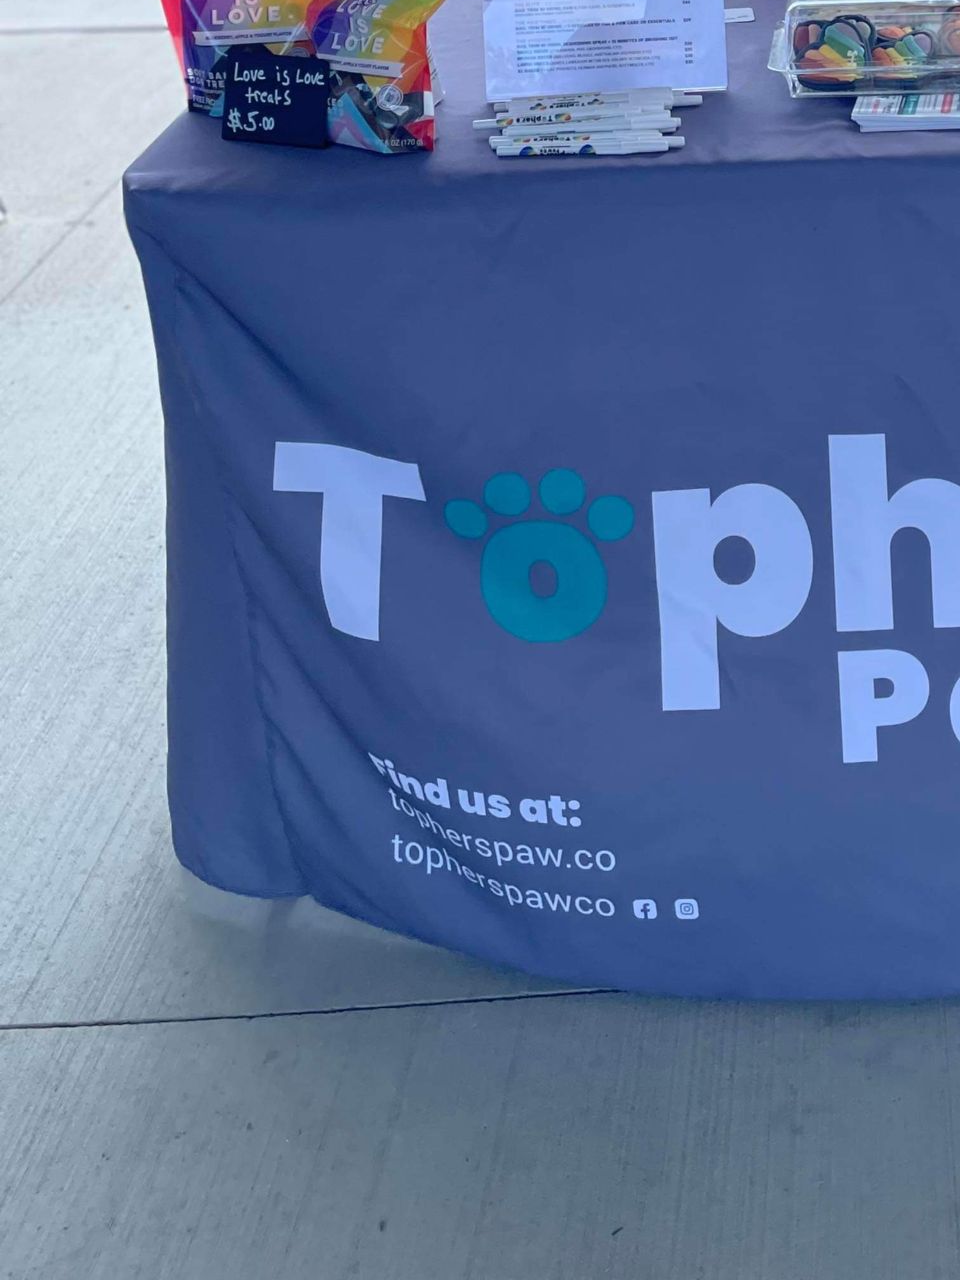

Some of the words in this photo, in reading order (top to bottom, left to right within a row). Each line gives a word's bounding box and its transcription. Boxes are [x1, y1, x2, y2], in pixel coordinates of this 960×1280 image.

[212, 6, 281, 25] LOVE
[350, 16, 369, 34] IS
[331, 31, 385, 54] LOVE
[234, 62, 266, 82] Love
[276, 65, 290, 86] is
[296, 68, 325, 86] Love
[245, 87, 291, 106] treats
[227, 107, 275, 133] $5.00
[458, 789, 511, 819] us
[519, 795, 582, 827] at:
[388, 787, 616, 871] topherspaw.co
[392, 834, 616, 917] topherspawco
